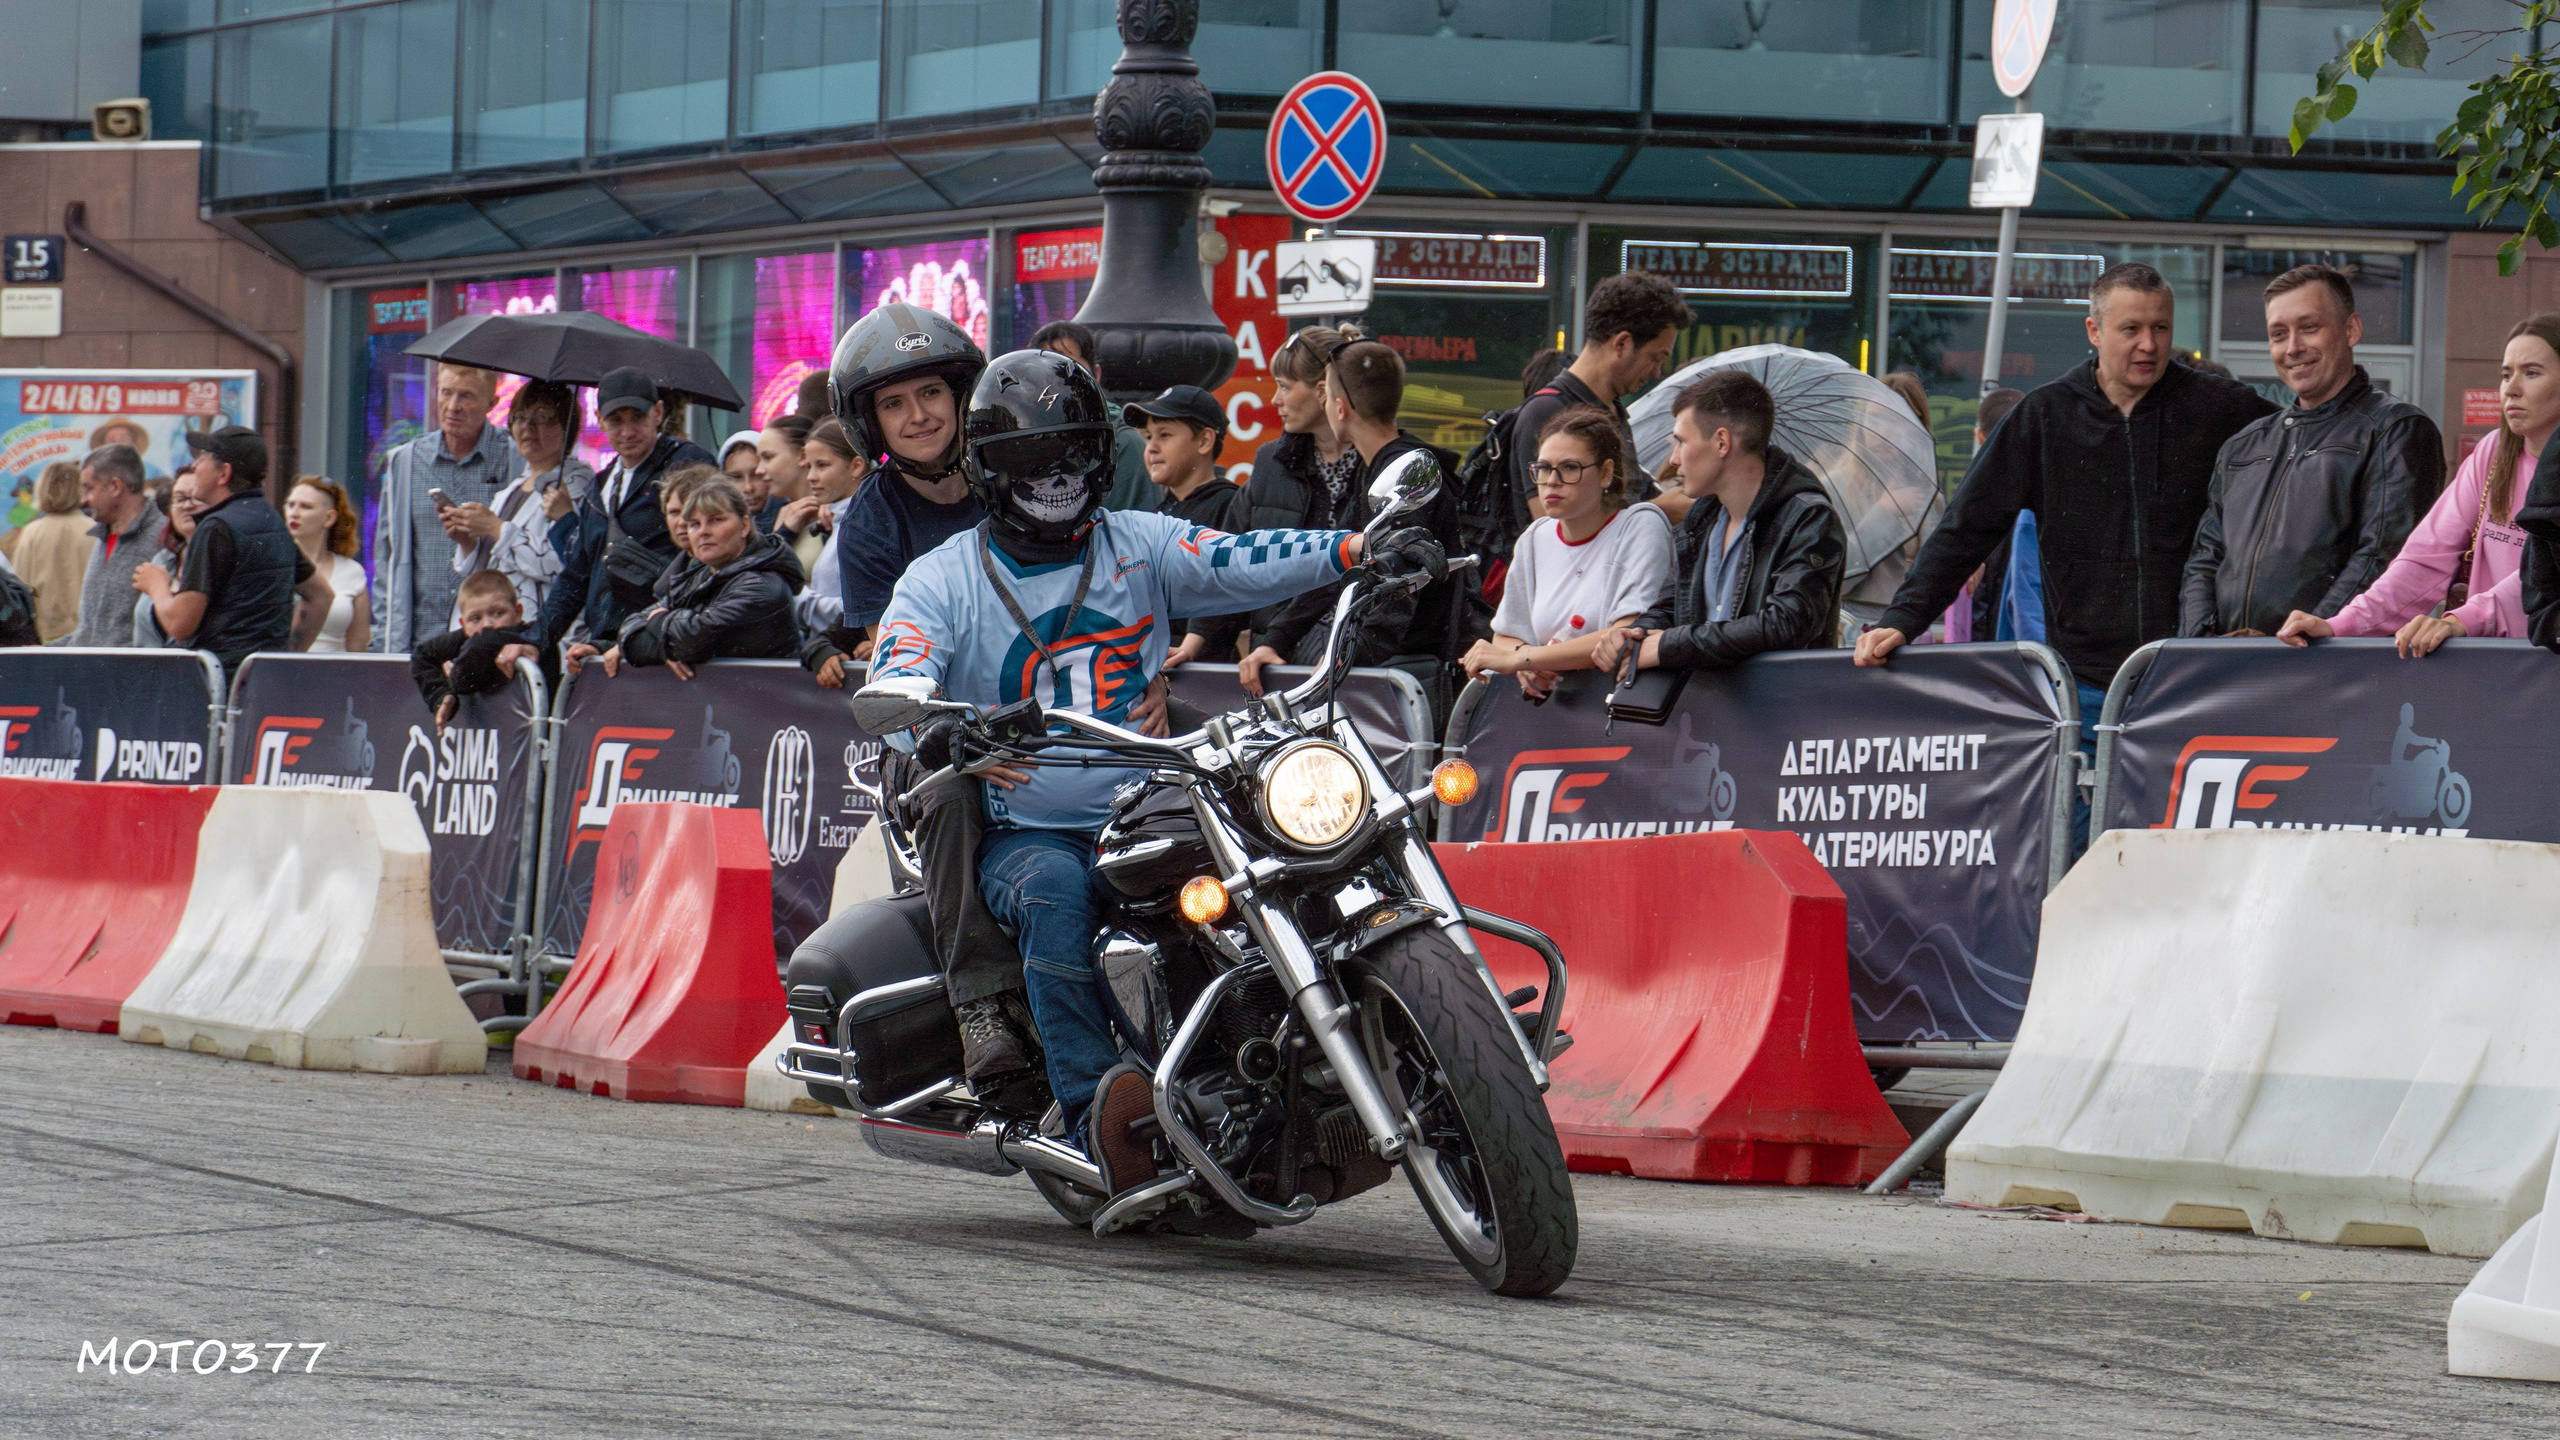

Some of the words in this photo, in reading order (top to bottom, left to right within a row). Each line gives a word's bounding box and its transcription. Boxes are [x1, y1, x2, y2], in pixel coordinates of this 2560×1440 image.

[14, 240, 49, 268] 15
[1022, 246, 1060, 271] ТЕАТР
[1061, 242, 1100, 268] ЭСТРА
[1410, 241, 1538, 268] ЭСТРАДЫ
[1630, 248, 1709, 272] ТЕАТР
[1721, 250, 1845, 279] ЭСТРАДЫ
[1891, 255, 1969, 279] ТЕАТР
[1977, 259, 2098, 286] ЭТРАДЫ
[898, 335, 928, 351] Cyril
[24, 384, 122, 412] 2/4/8/9
[2483, 528, 2511, 546] ради
[1017, 612, 1042, 643] YAMAHA
[117, 739, 203, 781] PRINZIP
[437, 726, 499, 781] SIMA
[844, 740, 882, 772] ФОН
[1780, 734, 1987, 776] ДЕПАРТАМЕНТ
[433, 783, 498, 836] LAND
[844, 794, 872, 807] СВЯТ
[1777, 783, 1927, 822] КУЛЬТУРЫ
[1796, 829, 1997, 867] АТЕРИНБУРГА
